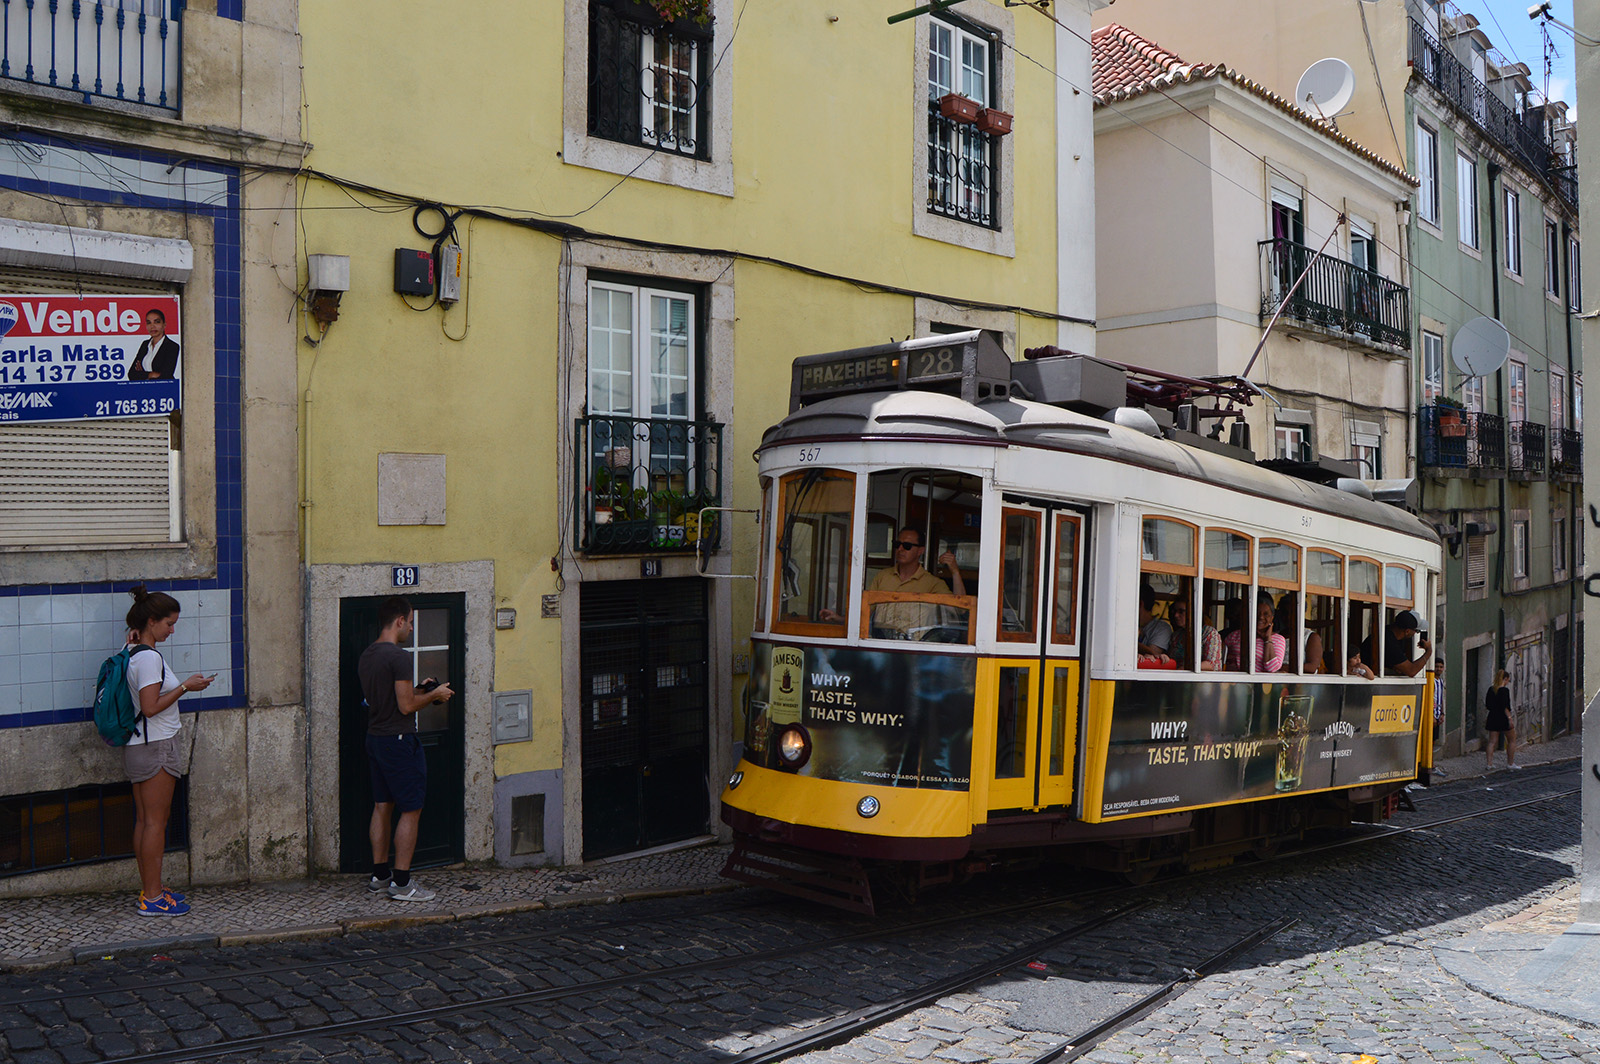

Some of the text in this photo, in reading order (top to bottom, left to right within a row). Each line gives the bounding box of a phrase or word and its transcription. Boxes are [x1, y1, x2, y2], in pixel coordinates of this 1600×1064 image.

[21, 302, 141, 334] Vende
[1, 344, 125, 364] arla Mata
[0, 363, 126, 383] 14 137 589
[803, 357, 887, 385] PRAZERES
[920, 349, 954, 376] 28
[0, 410, 19, 420] ais
[95, 397, 174, 415] 21 765 33 50
[799, 447, 821, 462] 567
[1301, 515, 1312, 527] 567
[396, 567, 415, 586] 89
[646, 560, 657, 576] 91
[811, 672, 851, 688] WHY?
[810, 689, 857, 708] TASTE,
[809, 706, 857, 723] THAT'S
[1374, 703, 1398, 722] carris
[1150, 720, 1188, 740] WHY?
[1323, 721, 1356, 741] JAMESON
[1148, 745, 1189, 766] TASTE,
[1193, 742, 1232, 762] THAT'S
[1320, 750, 1332, 759] IRISH
